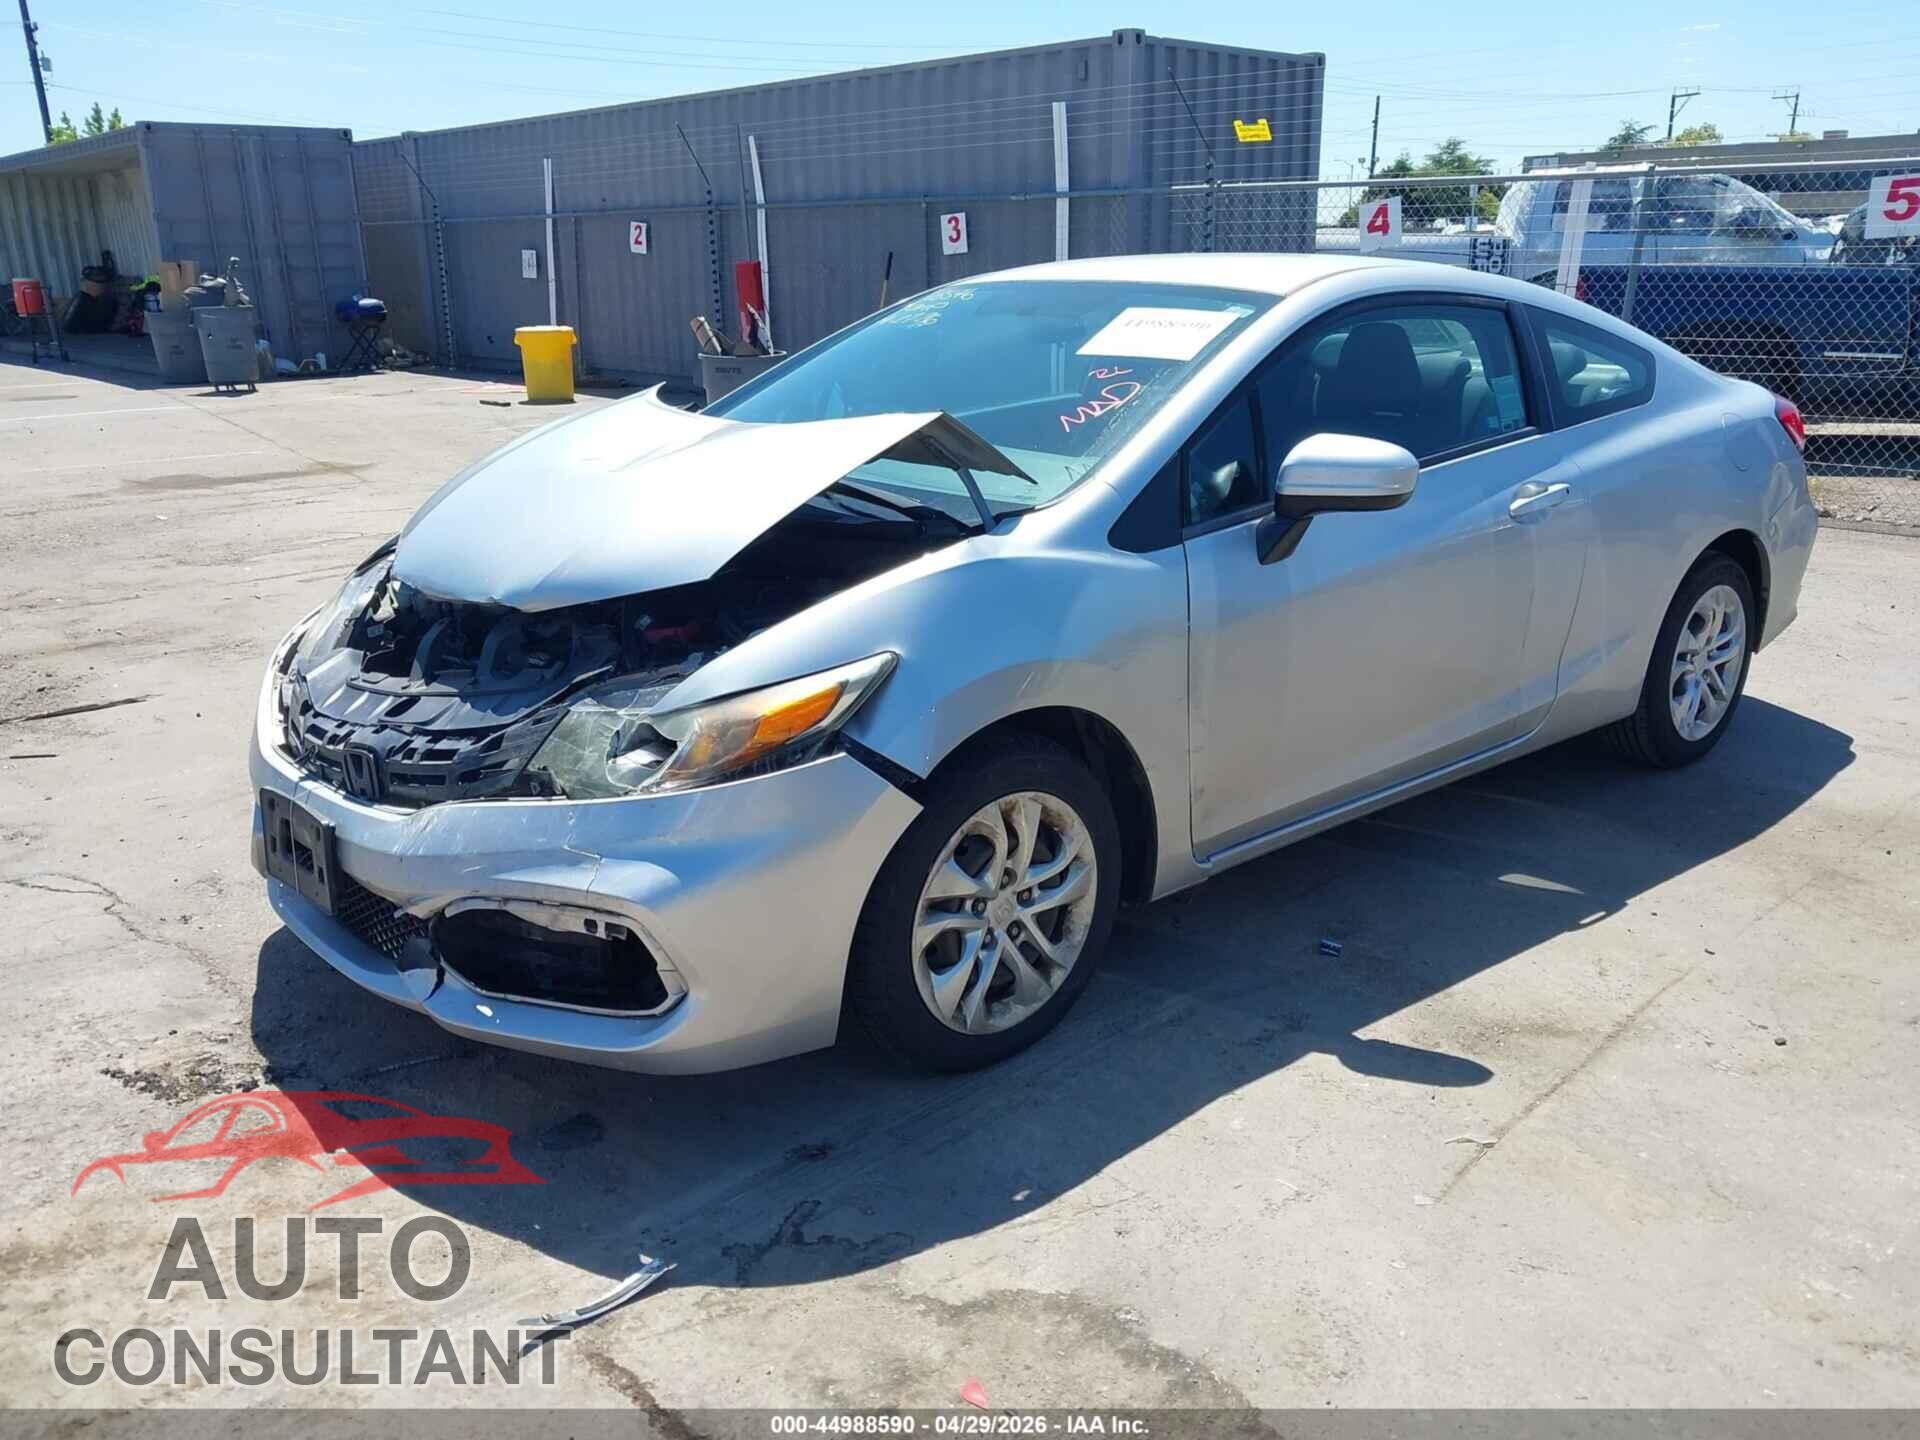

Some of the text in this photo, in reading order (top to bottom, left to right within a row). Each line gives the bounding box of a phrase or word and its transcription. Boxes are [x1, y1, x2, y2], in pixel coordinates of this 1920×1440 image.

[1882, 177, 1920, 221] 5
[634, 225, 643, 245] 2
[947, 215, 961, 243] 3
[1367, 203, 1390, 237] 4
